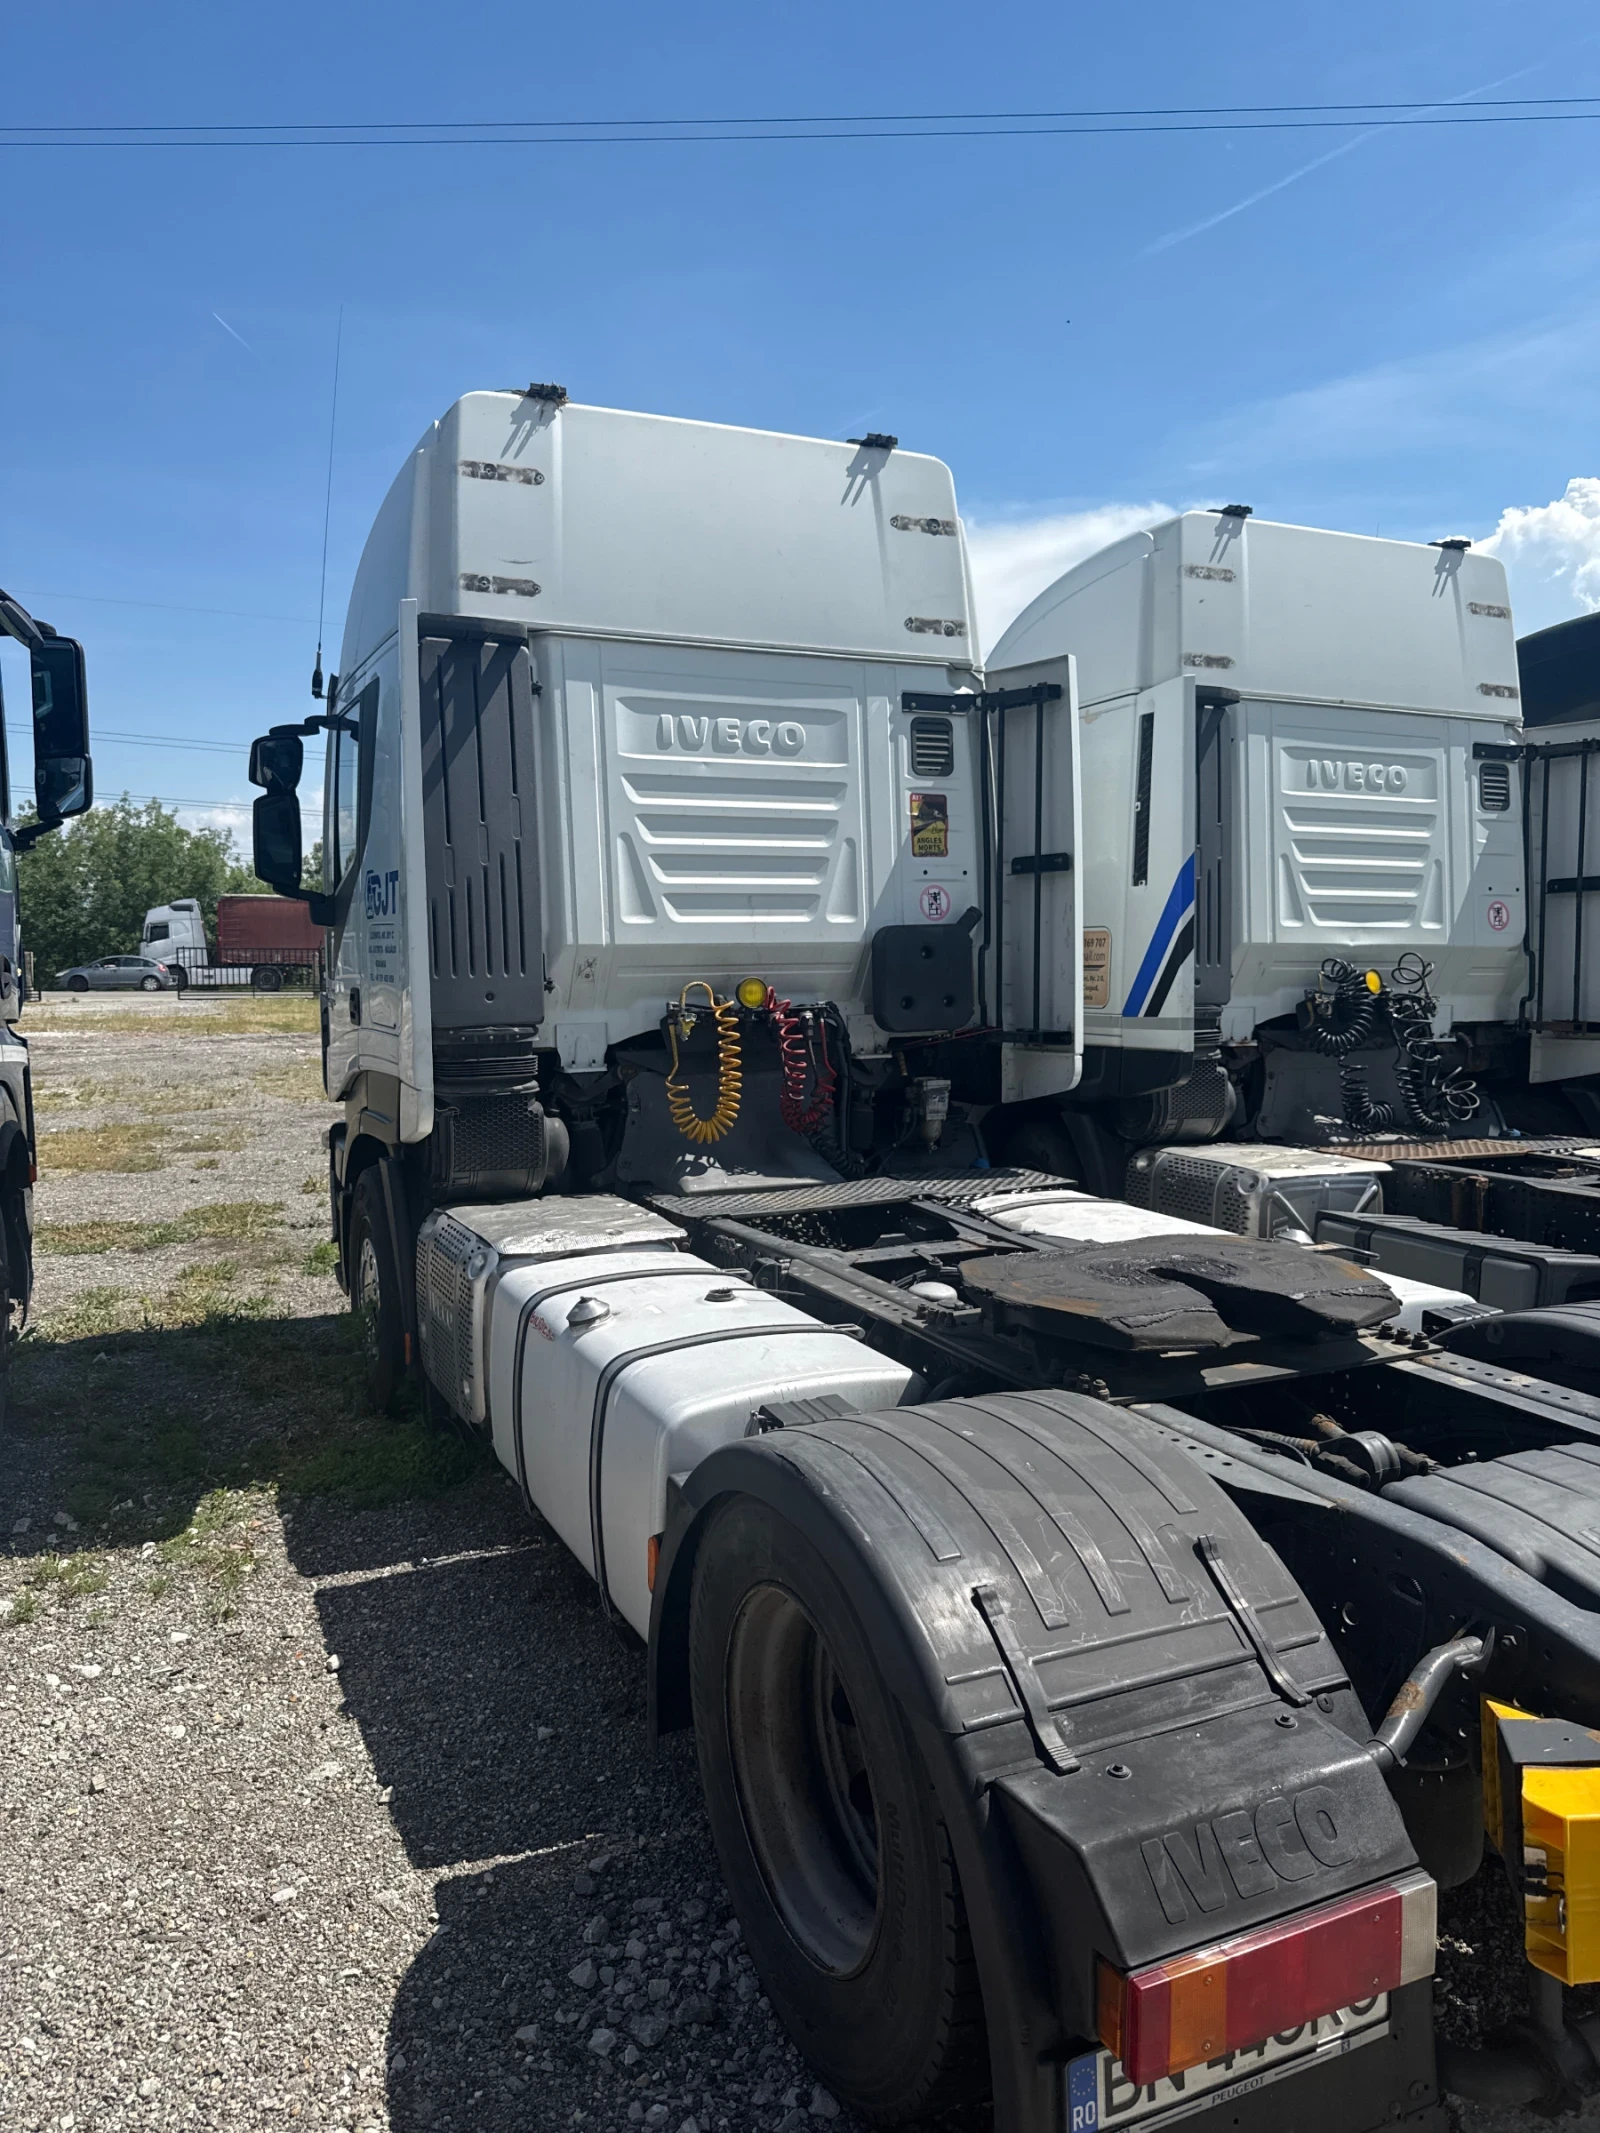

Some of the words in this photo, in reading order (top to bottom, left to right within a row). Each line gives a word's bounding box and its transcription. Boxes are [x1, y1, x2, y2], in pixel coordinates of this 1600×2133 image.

[658, 714, 807, 756] IVECO
[1307, 759, 1408, 793] IVECO
[1096, 937, 1106, 948] 707
[1140, 1785, 1357, 1925] IVECO
[1211, 2074, 1266, 2105] PEUGEOT
[1072, 2100, 1097, 2132] RO
